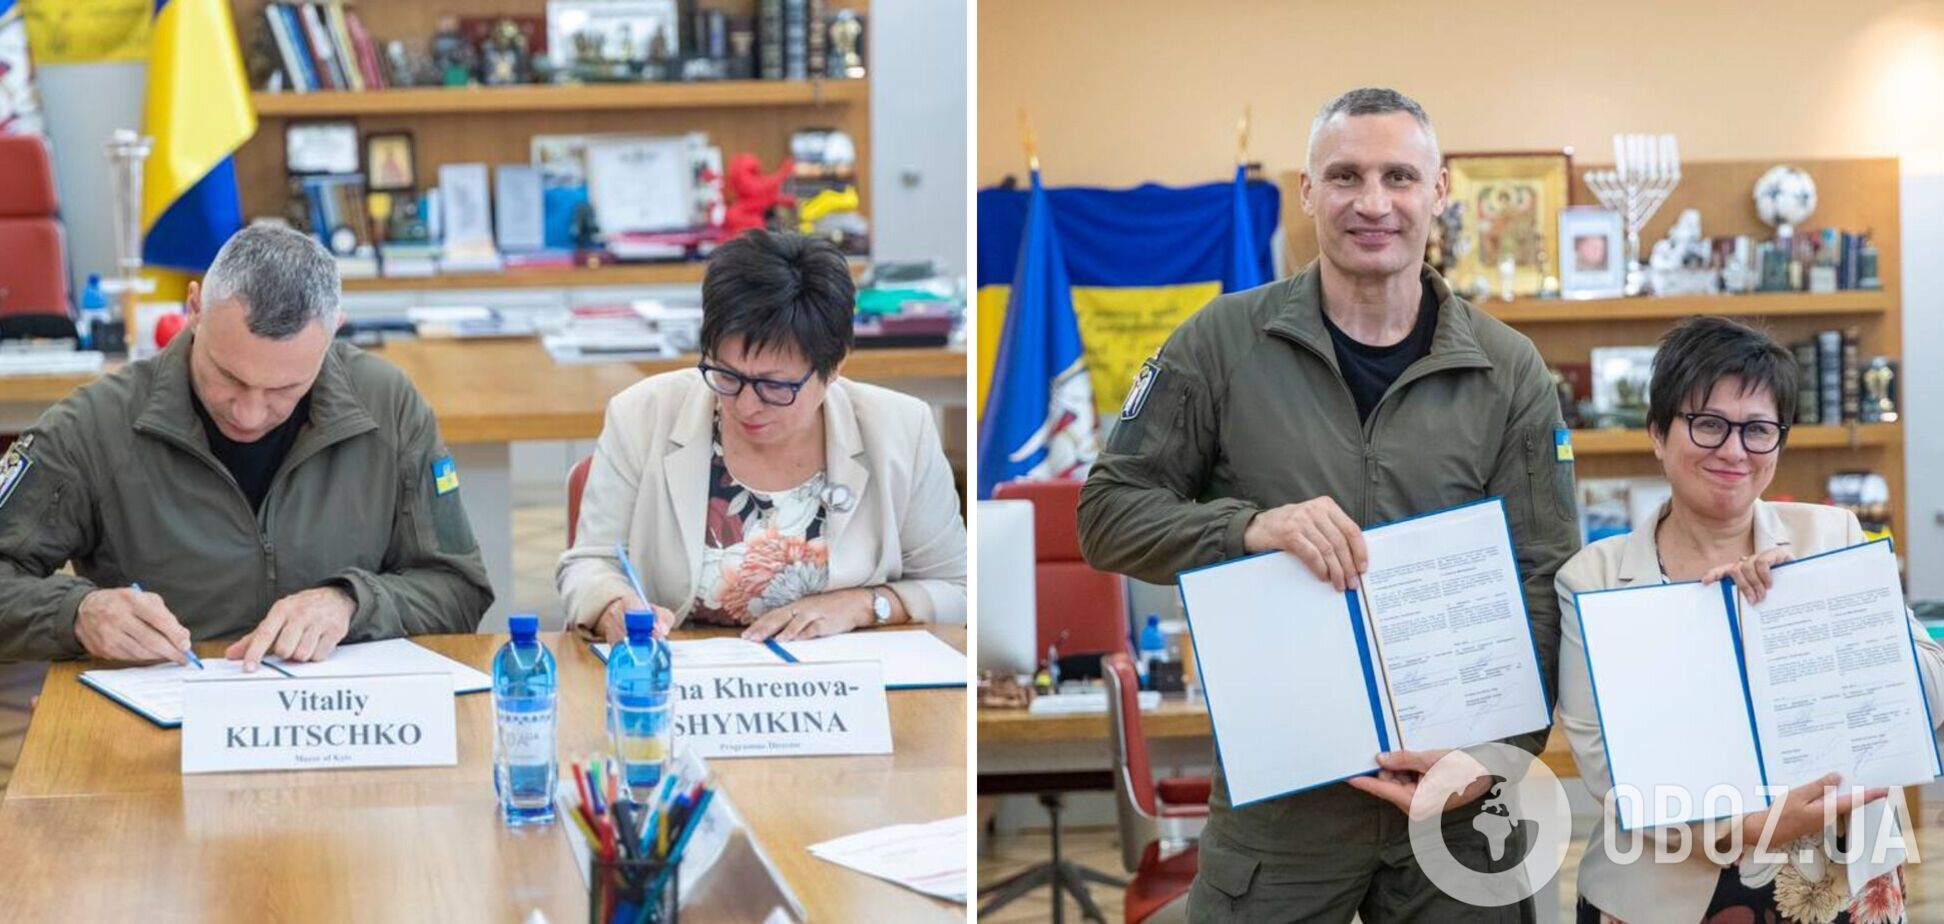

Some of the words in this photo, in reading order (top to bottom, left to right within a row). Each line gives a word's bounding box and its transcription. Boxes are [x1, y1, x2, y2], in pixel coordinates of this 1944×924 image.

[713, 676, 860, 700] Khrenova-
[278, 689, 369, 716] Vitaliy
[226, 723, 422, 749] KLITSCHKO
[674, 711, 848, 737] SHYMKINA
